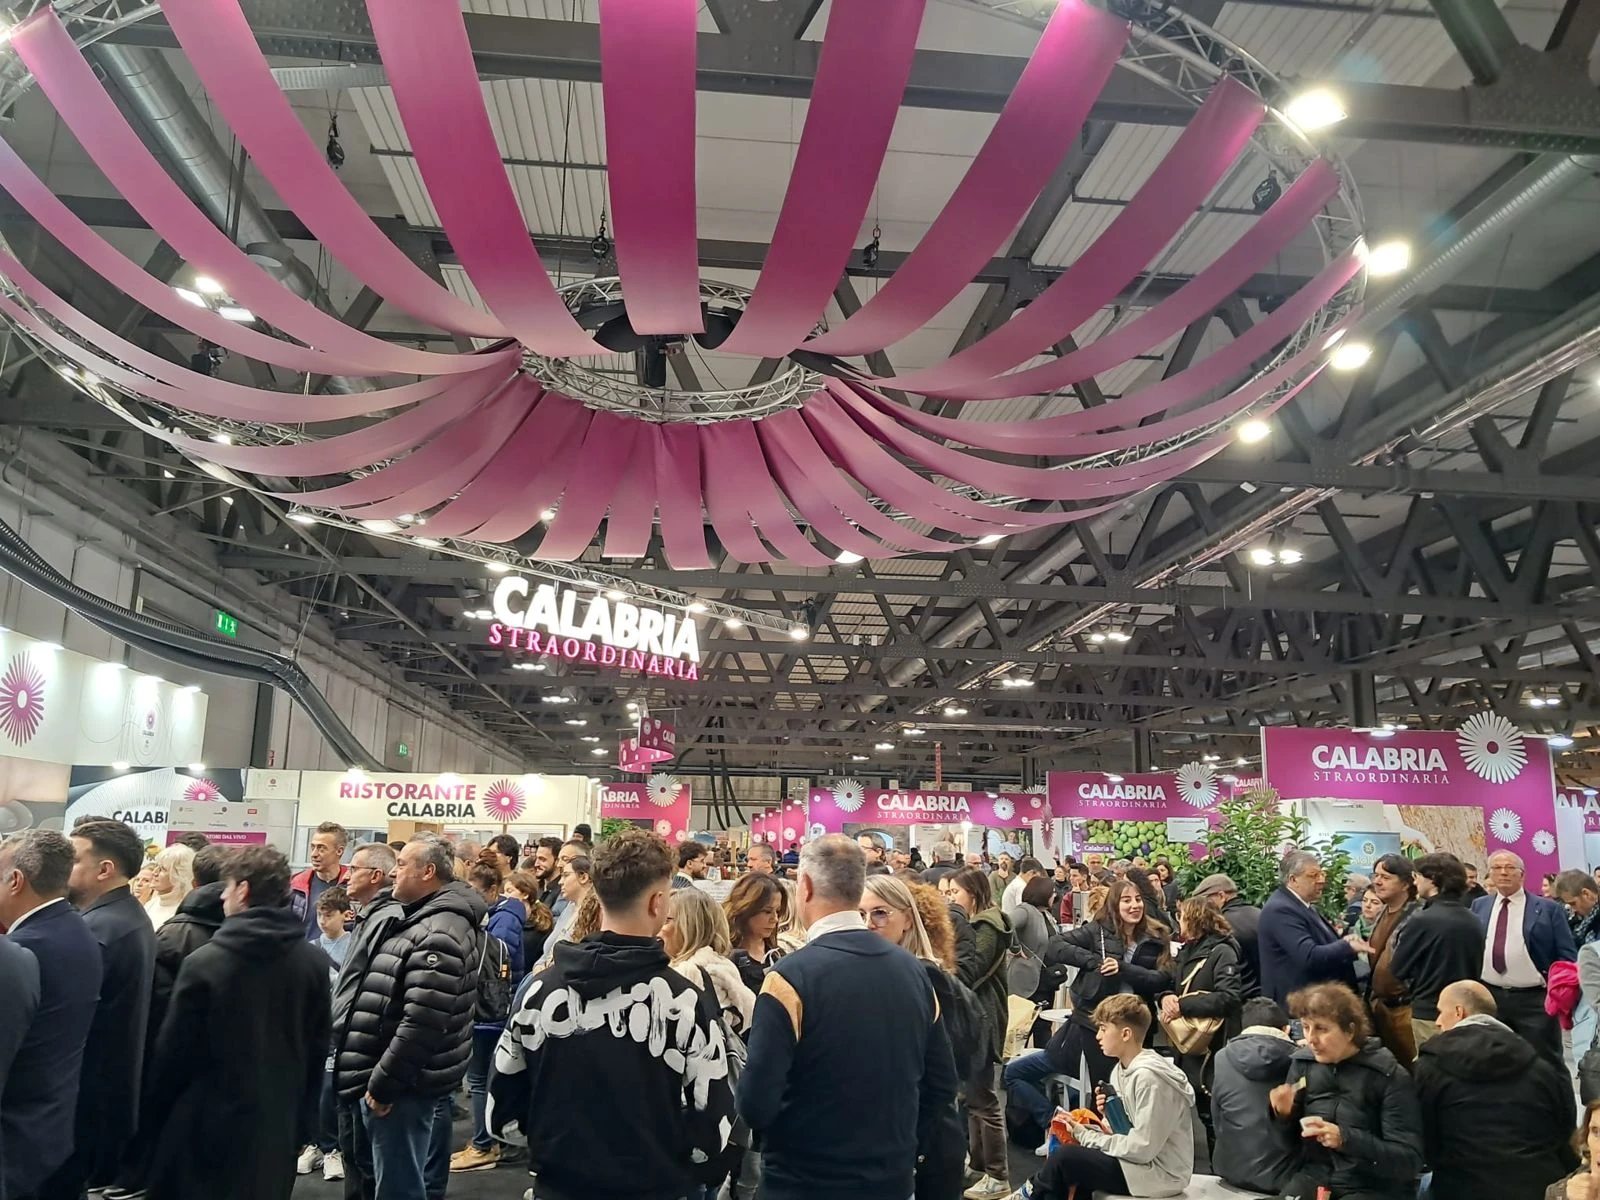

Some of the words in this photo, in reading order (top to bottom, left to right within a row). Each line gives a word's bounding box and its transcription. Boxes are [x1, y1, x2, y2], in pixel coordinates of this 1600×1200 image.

[492, 576, 700, 662] CALABRIA
[489, 623, 699, 681] STRAORDINARIA
[1311, 745, 1448, 772] CALABRIA
[1313, 771, 1450, 785] STRAORDINARIA
[339, 782, 476, 801] RISTORANTE
[1078, 783, 1166, 801] CALABRIA
[386, 802, 476, 818] CALABRIA
[877, 793, 970, 812] CALABRIA
[1078, 799, 1168, 809] STRAORDINARIA
[877, 811, 971, 821] STRAORDINARIA
